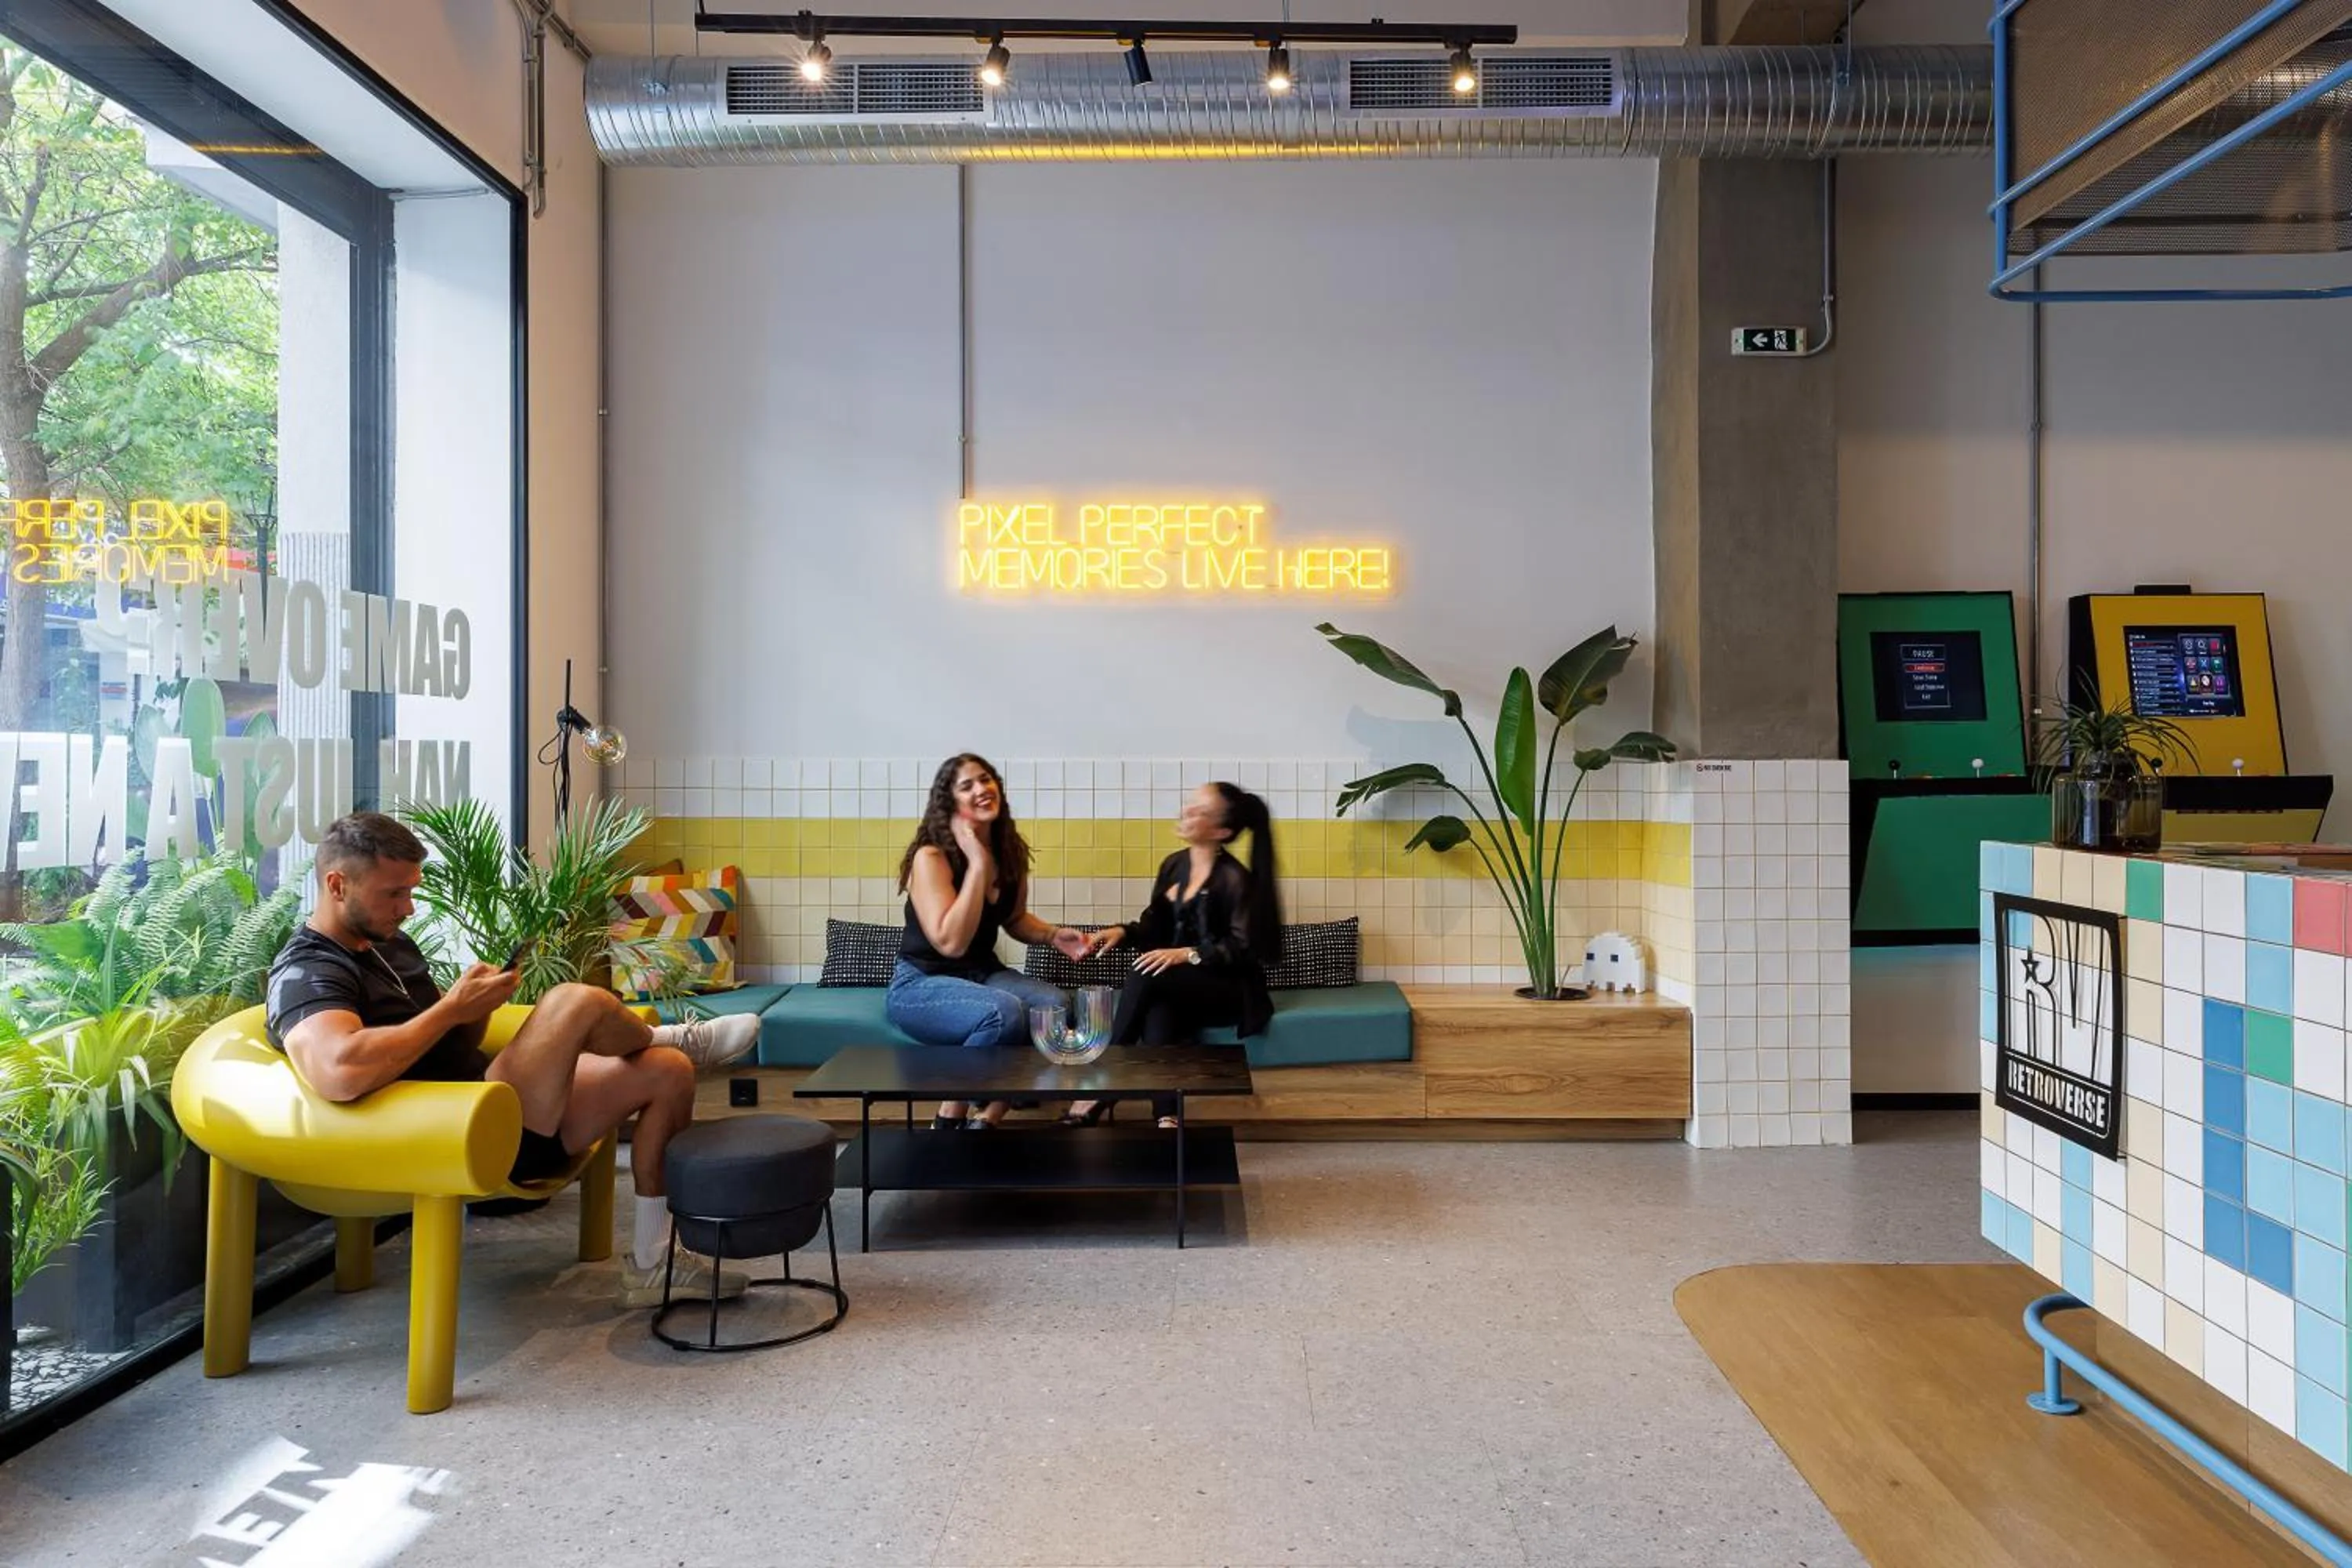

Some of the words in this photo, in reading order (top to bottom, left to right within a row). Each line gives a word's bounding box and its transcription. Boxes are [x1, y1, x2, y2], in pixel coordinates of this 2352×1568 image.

[958, 503, 1067, 546] PIXEL
[1079, 503, 1265, 546] PERFECT
[958, 548, 1168, 590] MEMORIES
[1181, 548, 1268, 590] LIVE
[1277, 547, 1392, 590] HERE!
[2007, 1058, 2107, 1129] RETROVERSE
